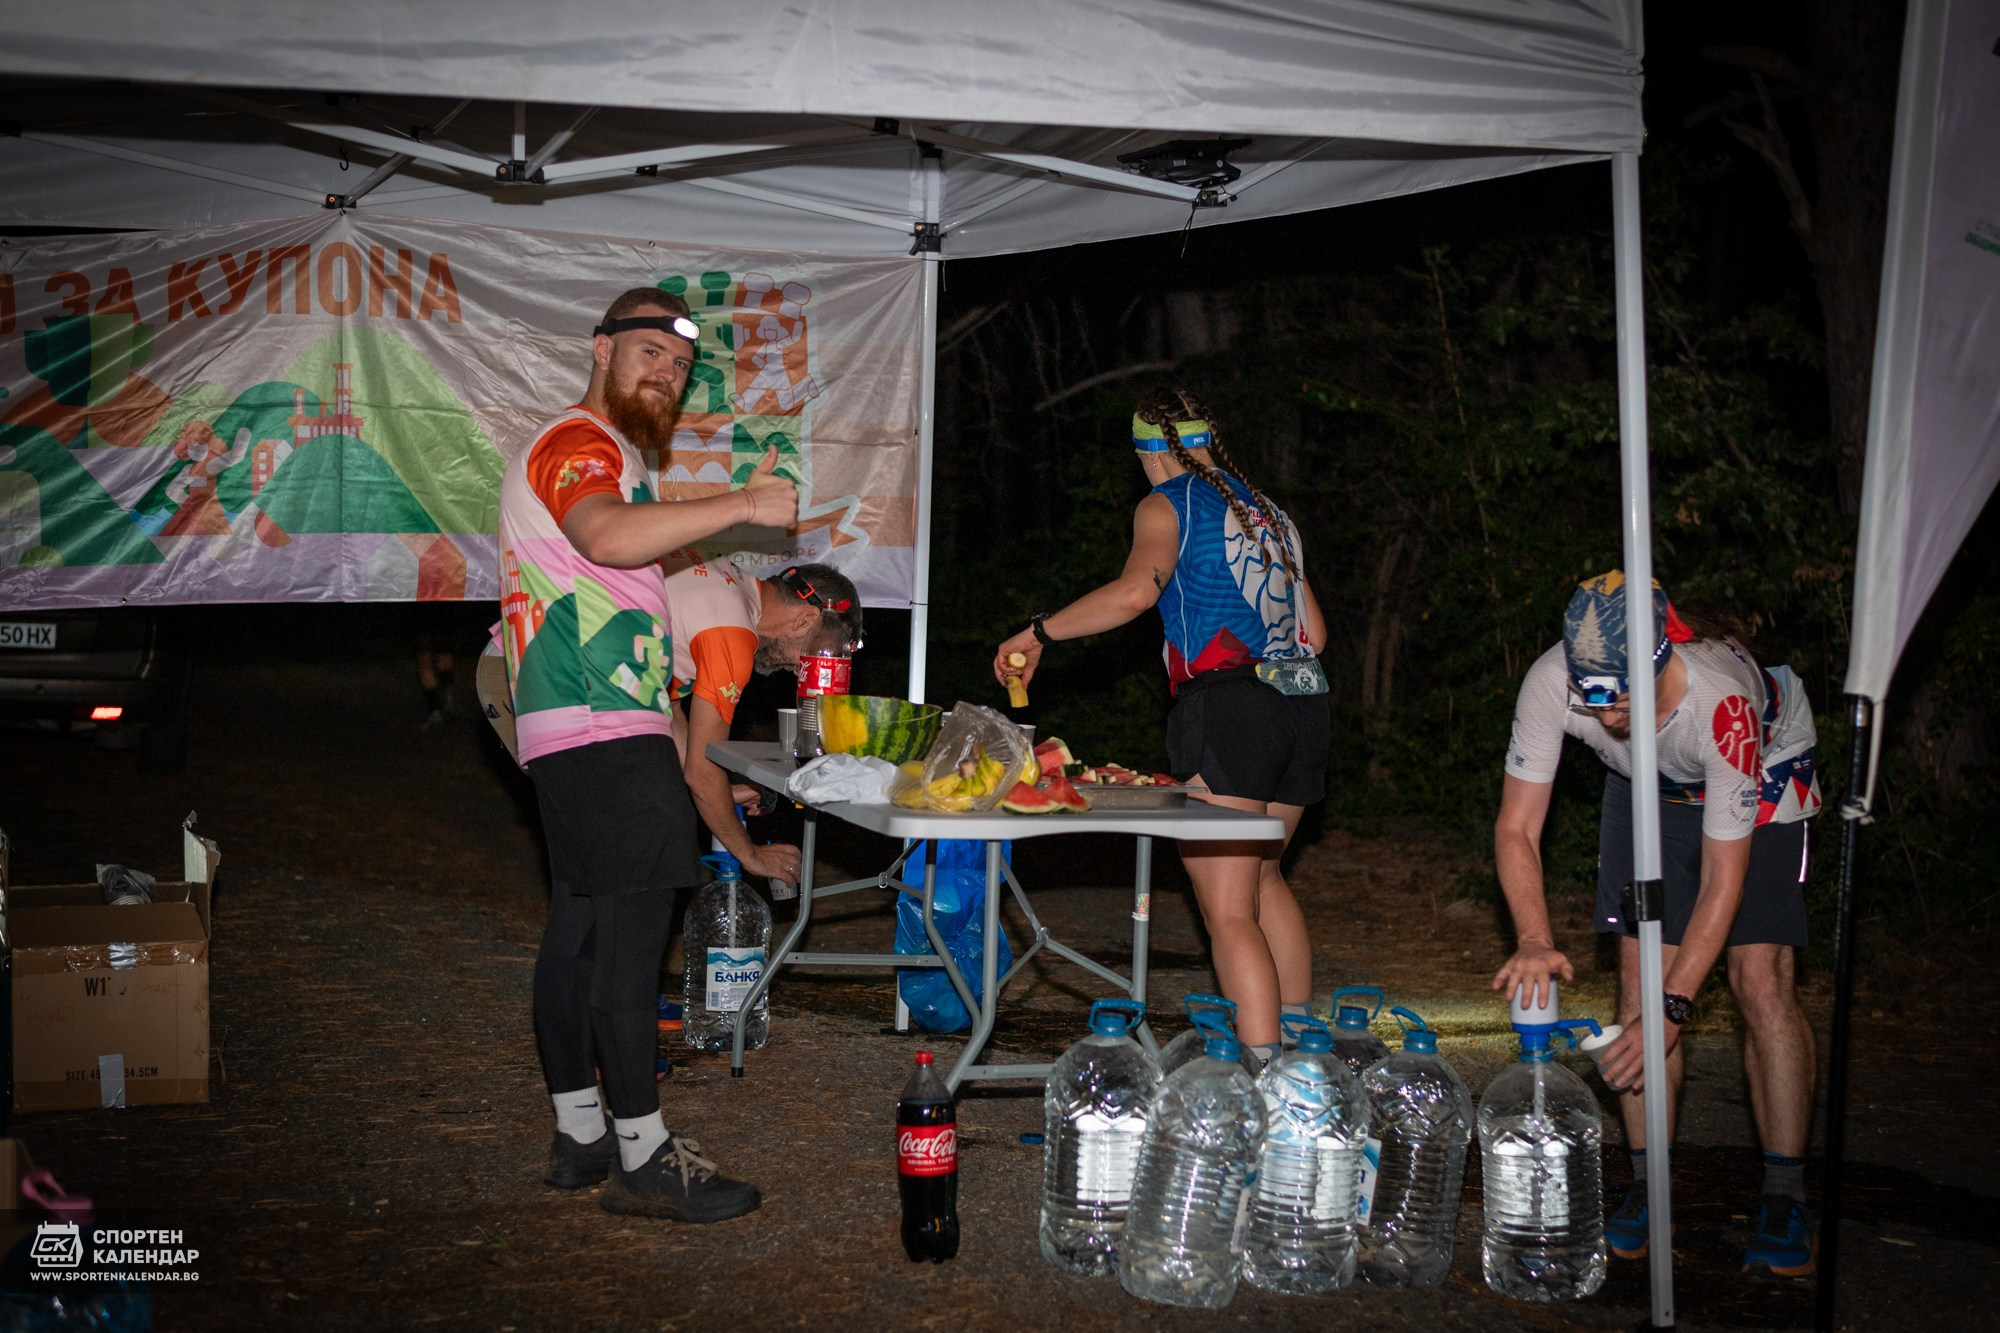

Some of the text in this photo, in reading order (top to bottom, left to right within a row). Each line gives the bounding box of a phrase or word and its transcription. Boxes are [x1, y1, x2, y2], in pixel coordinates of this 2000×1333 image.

[42, 267, 142, 326] ЗА
[167, 241, 464, 323] КУПОНА
[729, 543, 816, 566] АМБОРЕ
[27, 627, 52, 645] HX
[714, 971, 761, 983] БАНКЯ
